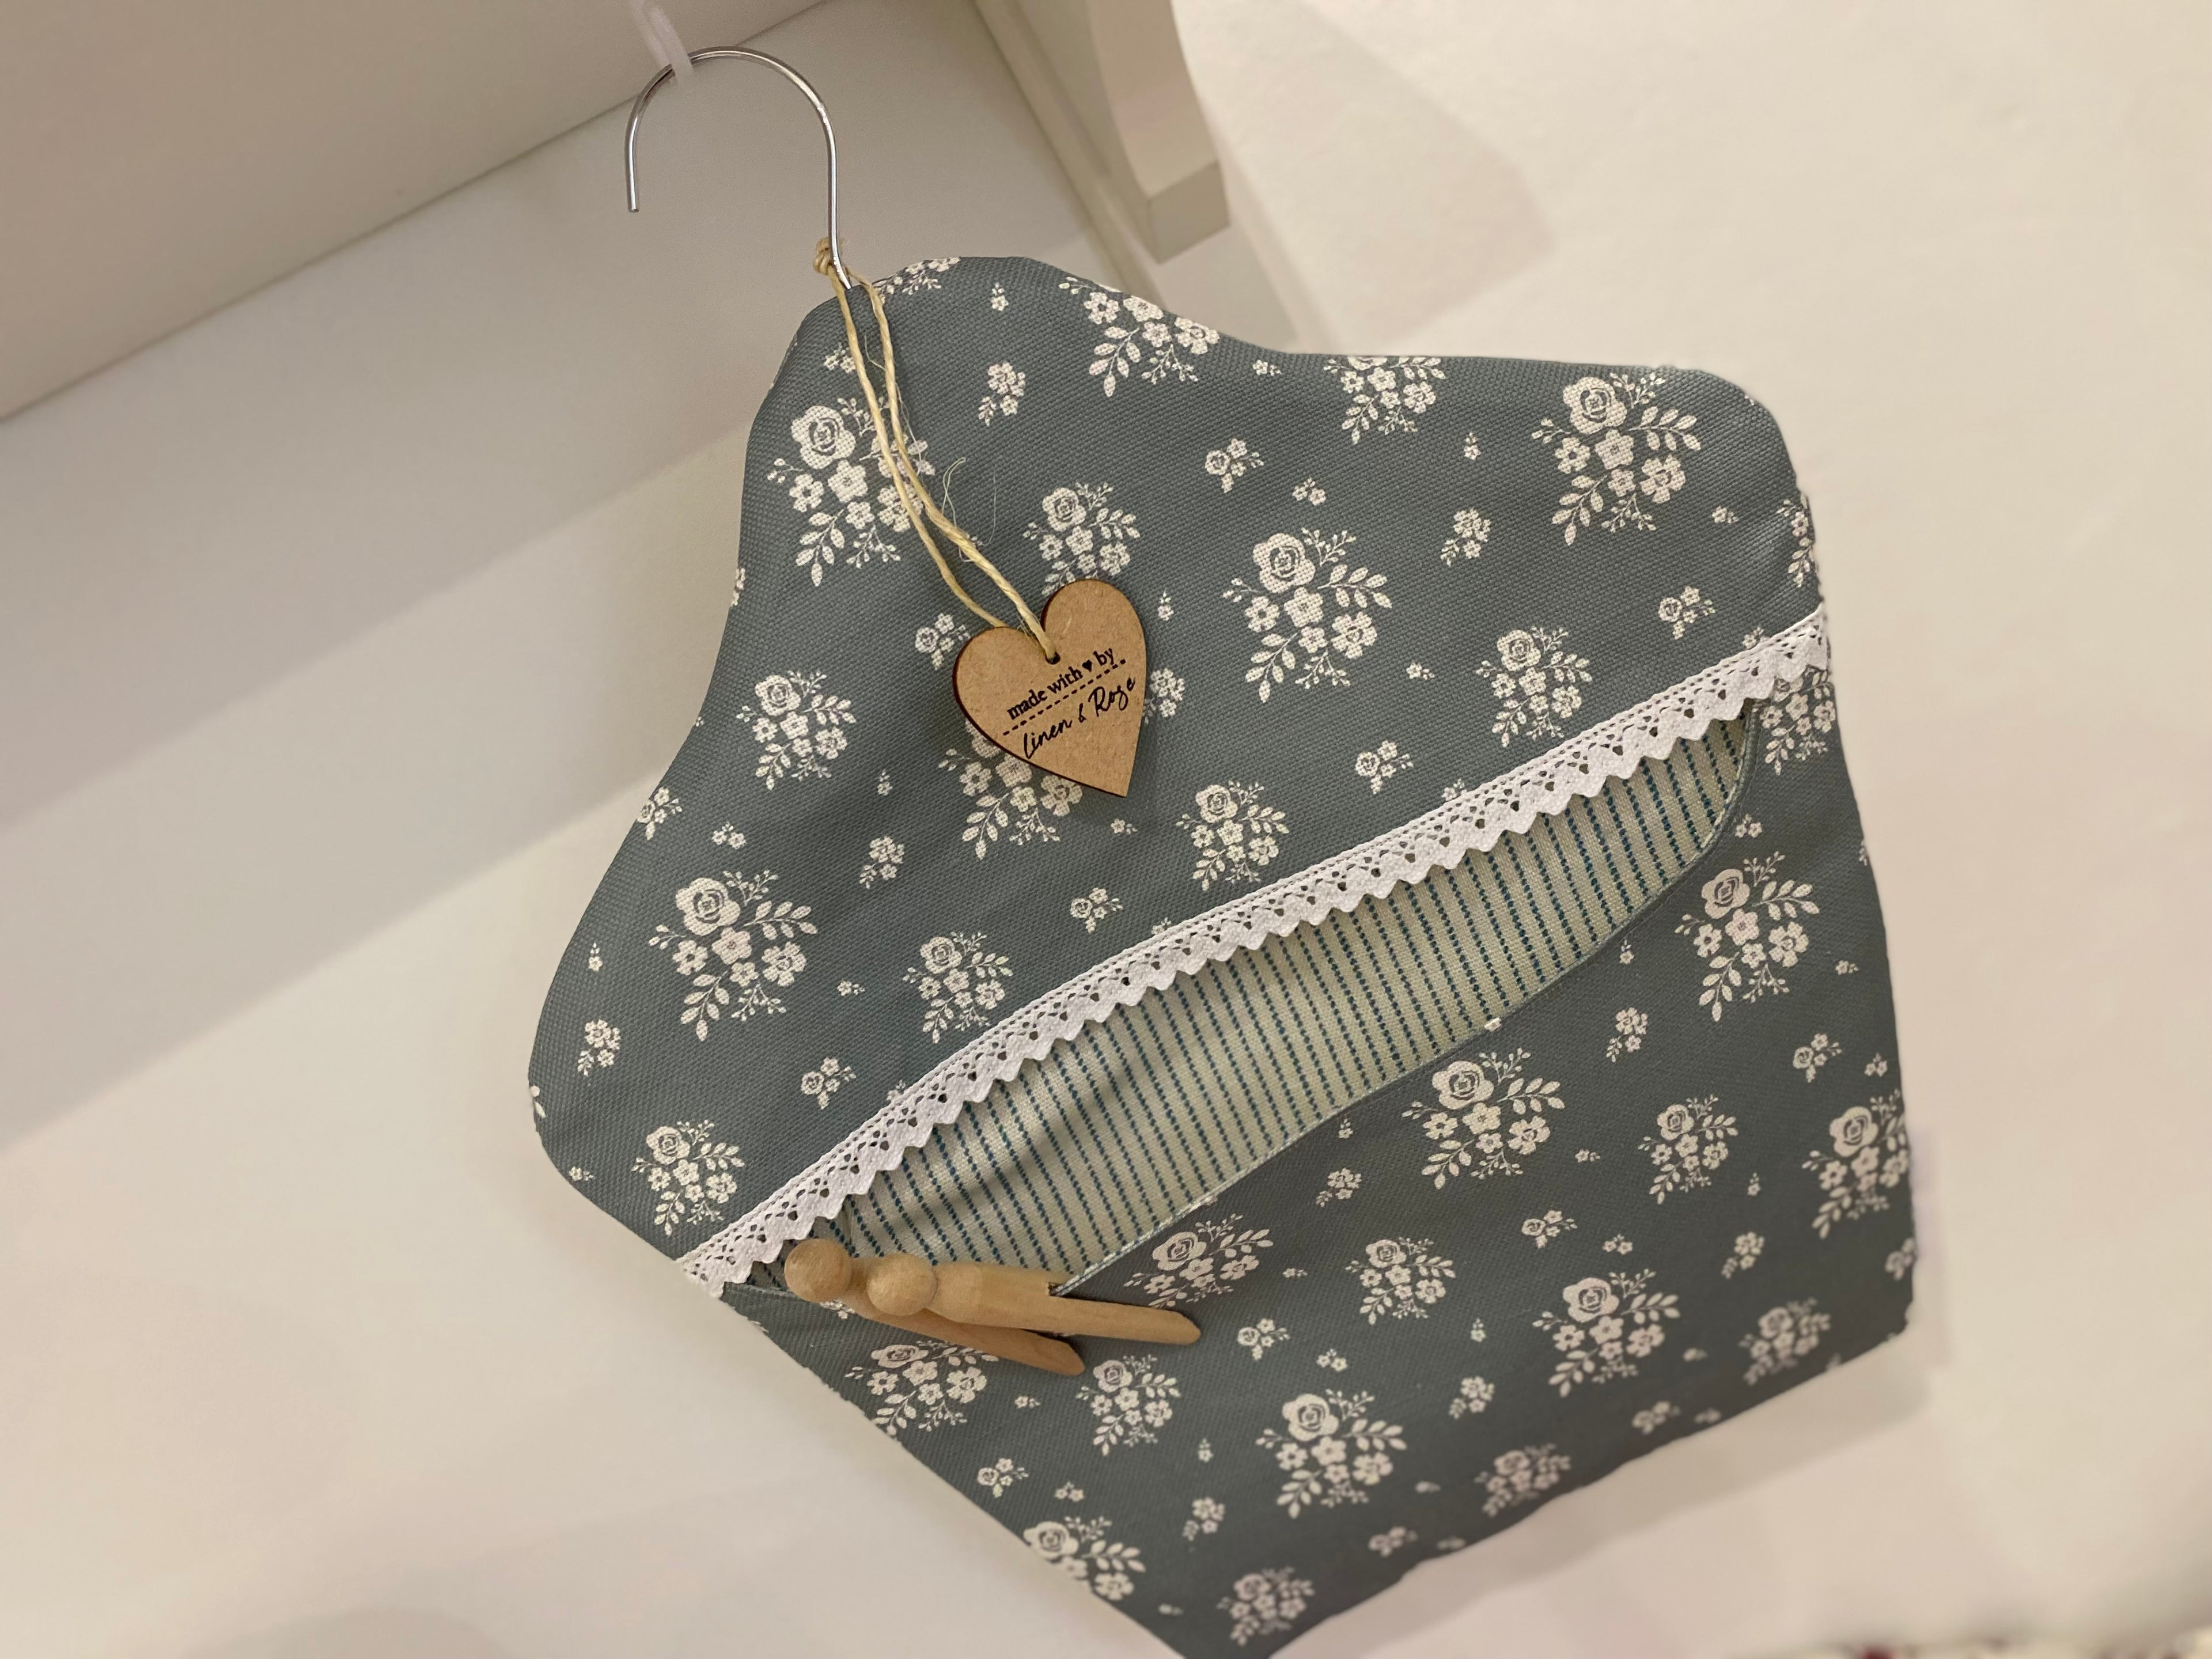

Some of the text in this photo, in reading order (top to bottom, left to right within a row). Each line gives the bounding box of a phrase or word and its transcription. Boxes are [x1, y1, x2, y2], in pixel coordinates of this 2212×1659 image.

[1007, 648, 1113, 720] made with by
[1088, 676, 1136, 717] Rose
